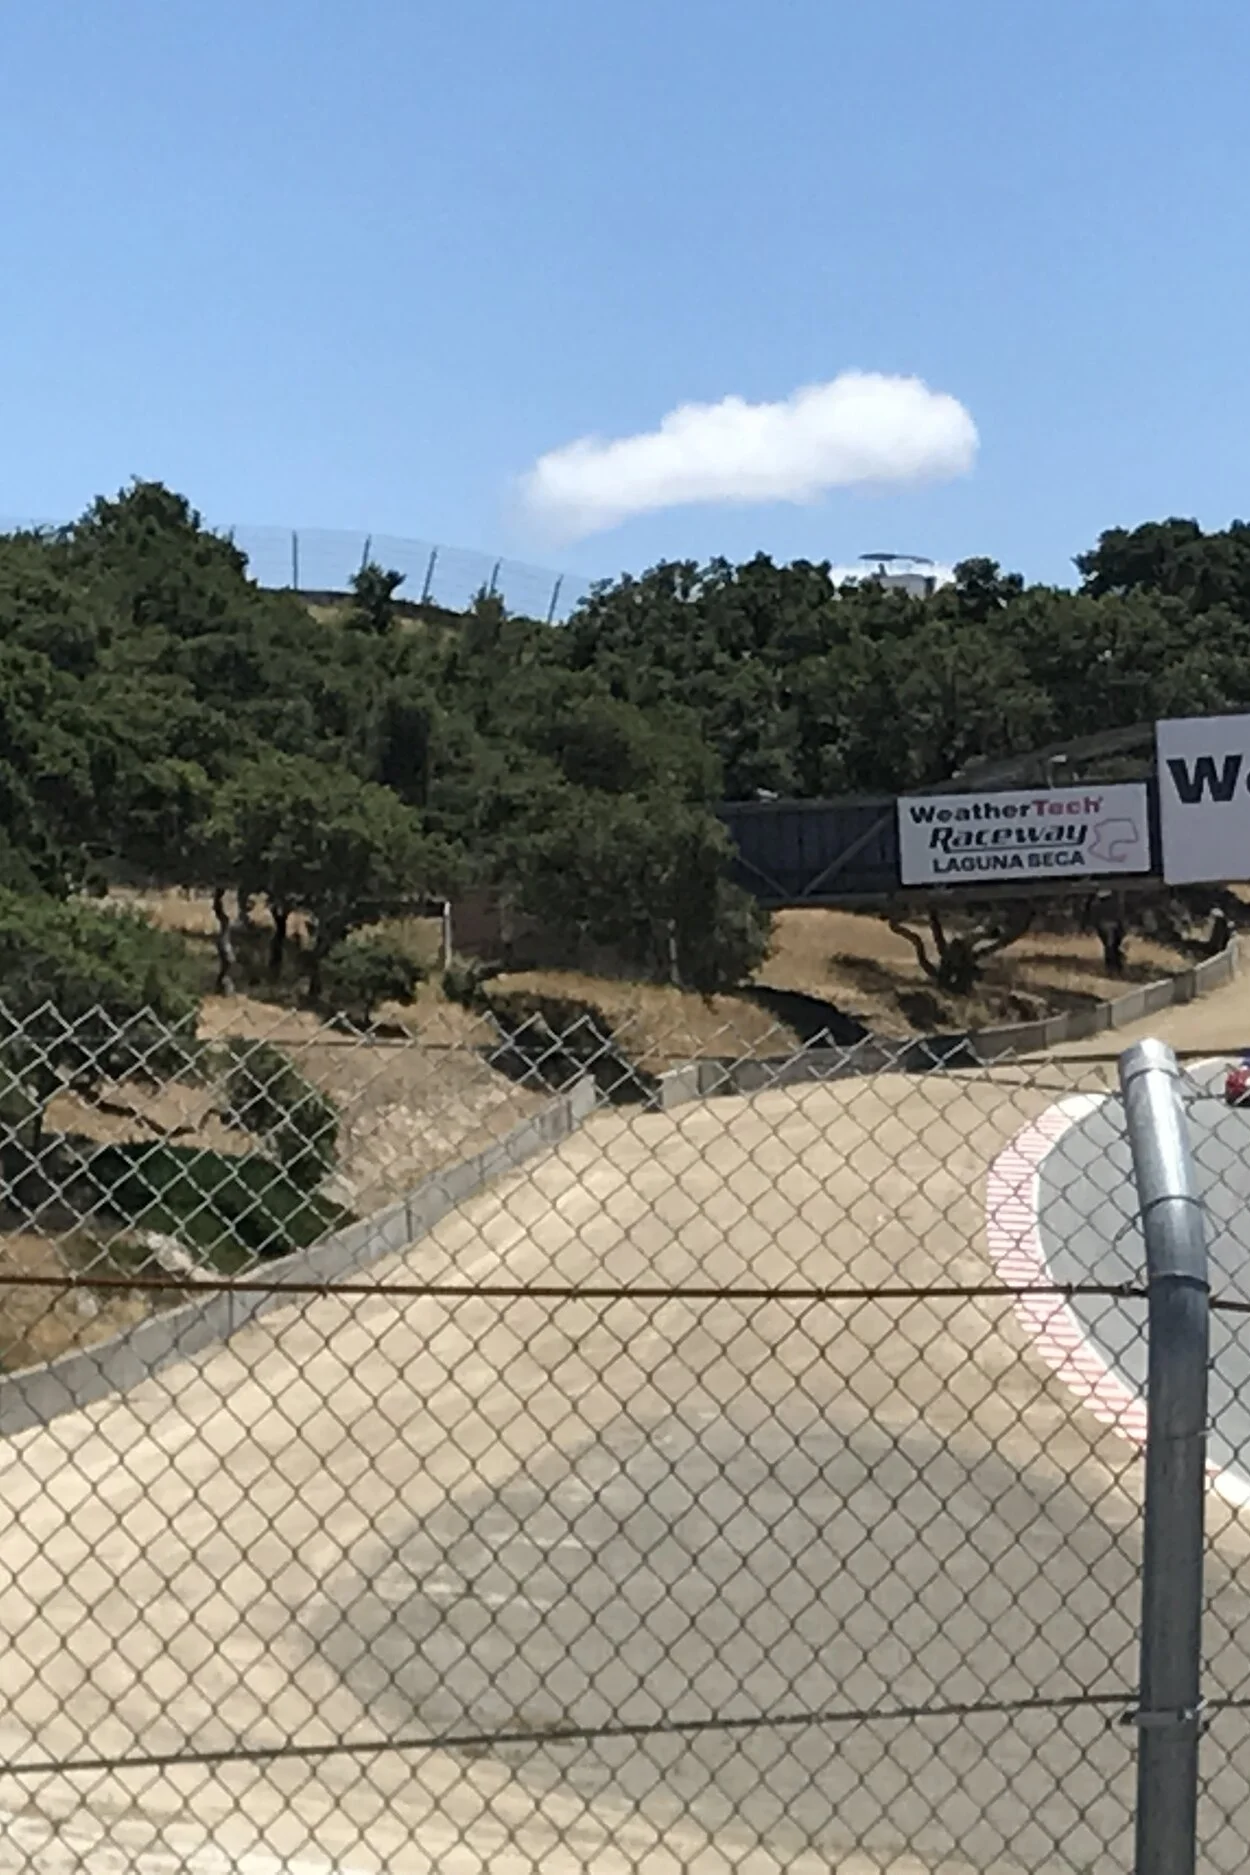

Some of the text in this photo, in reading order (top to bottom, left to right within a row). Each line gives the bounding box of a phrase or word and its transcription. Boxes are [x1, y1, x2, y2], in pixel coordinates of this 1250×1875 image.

[910, 796, 1103, 824] WeatherTech
[929, 824, 1088, 854] Raceway
[933, 851, 1085, 874] LAGUNA SECA
